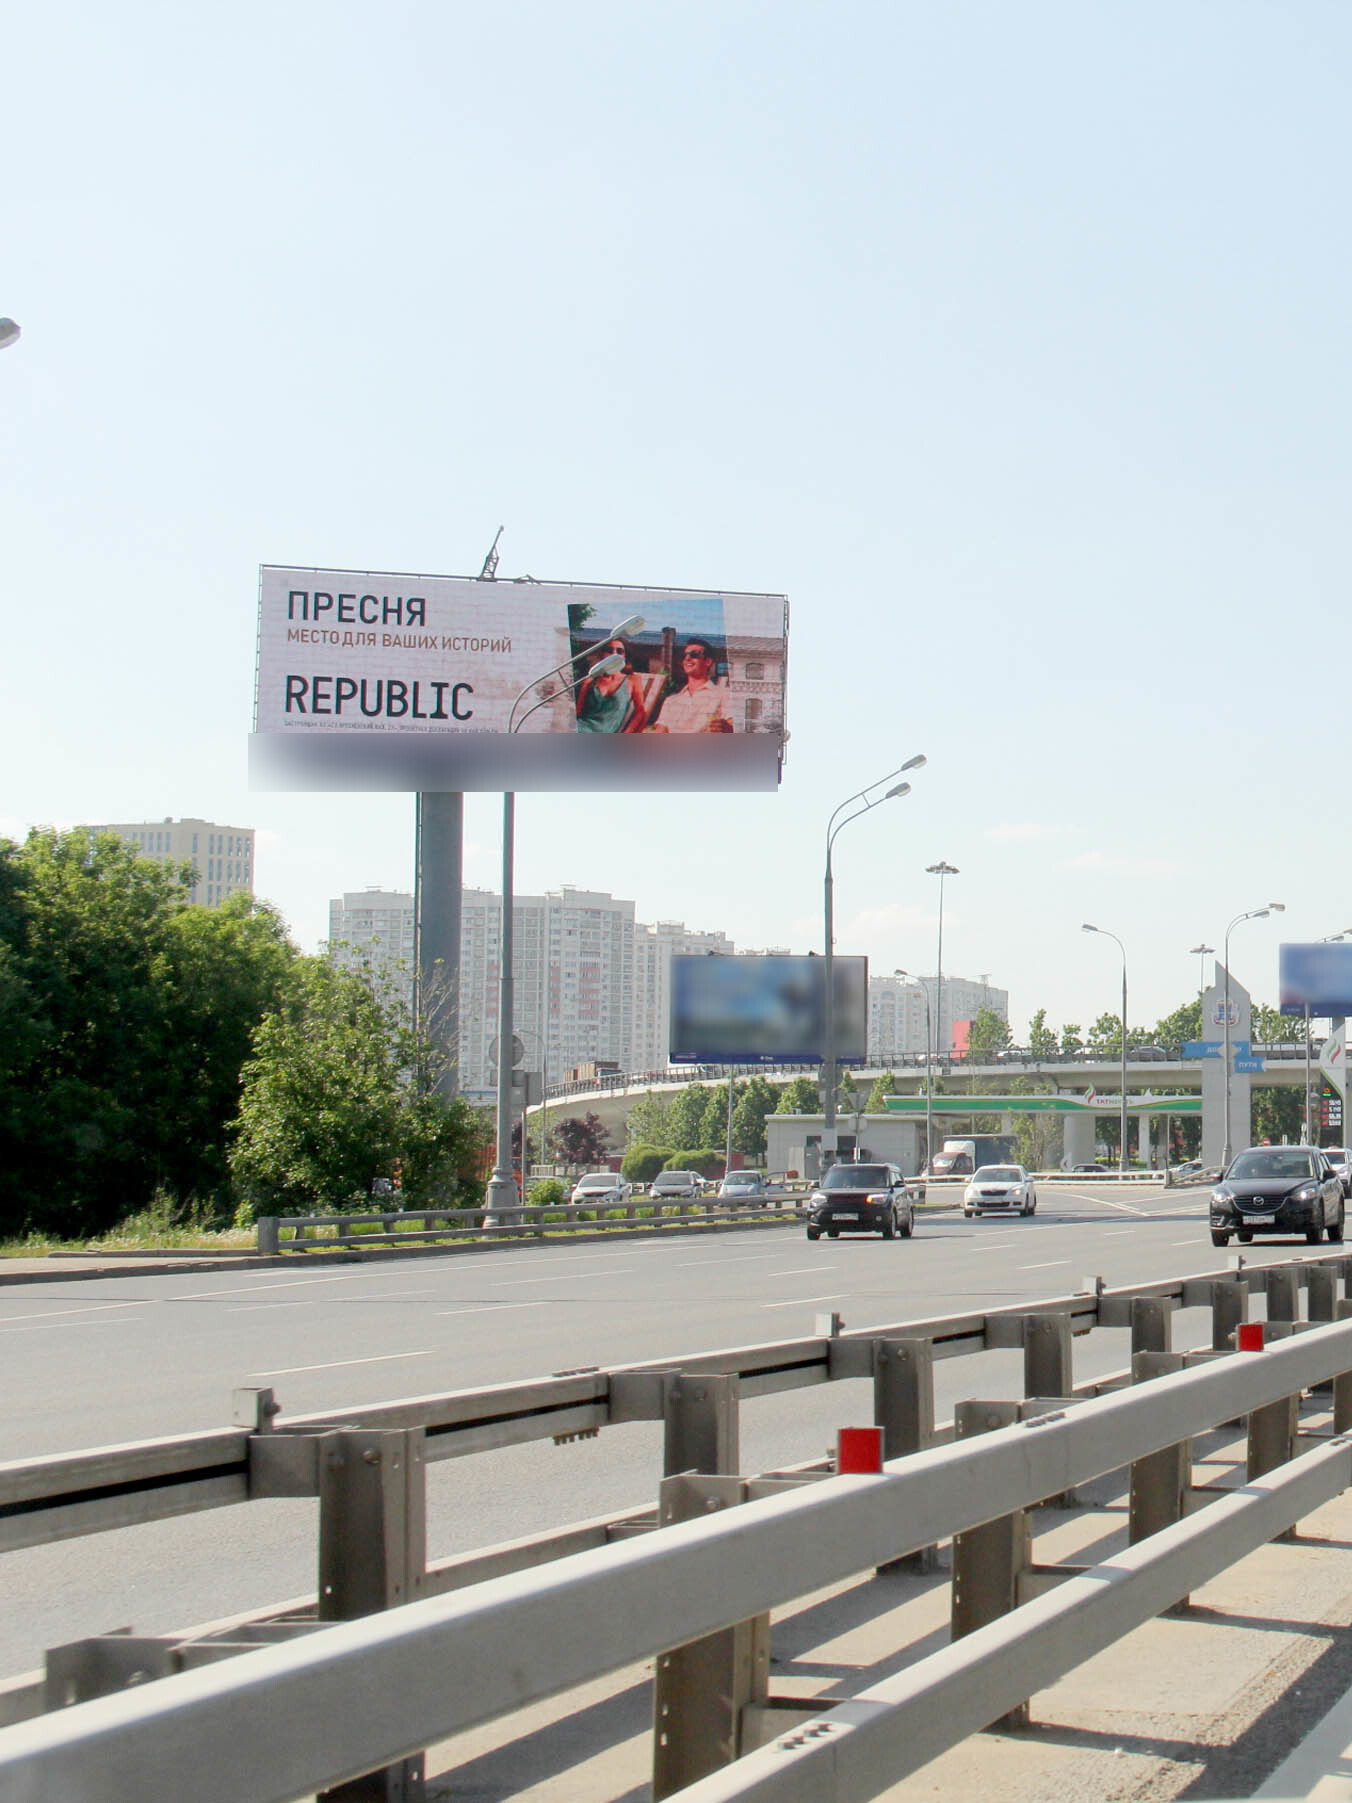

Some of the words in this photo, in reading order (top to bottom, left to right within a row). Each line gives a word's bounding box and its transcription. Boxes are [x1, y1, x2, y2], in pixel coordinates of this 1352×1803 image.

[288, 590, 426, 627] ПРЕСНЯ
[287, 628, 340, 645] МЕСТО
[342, 631, 377, 648] ДЛЯ
[382, 633, 440, 650] ВАШИХ
[442, 636, 512, 654] ИСТОРИЙ
[285, 674, 474, 721] REPUBLIC
